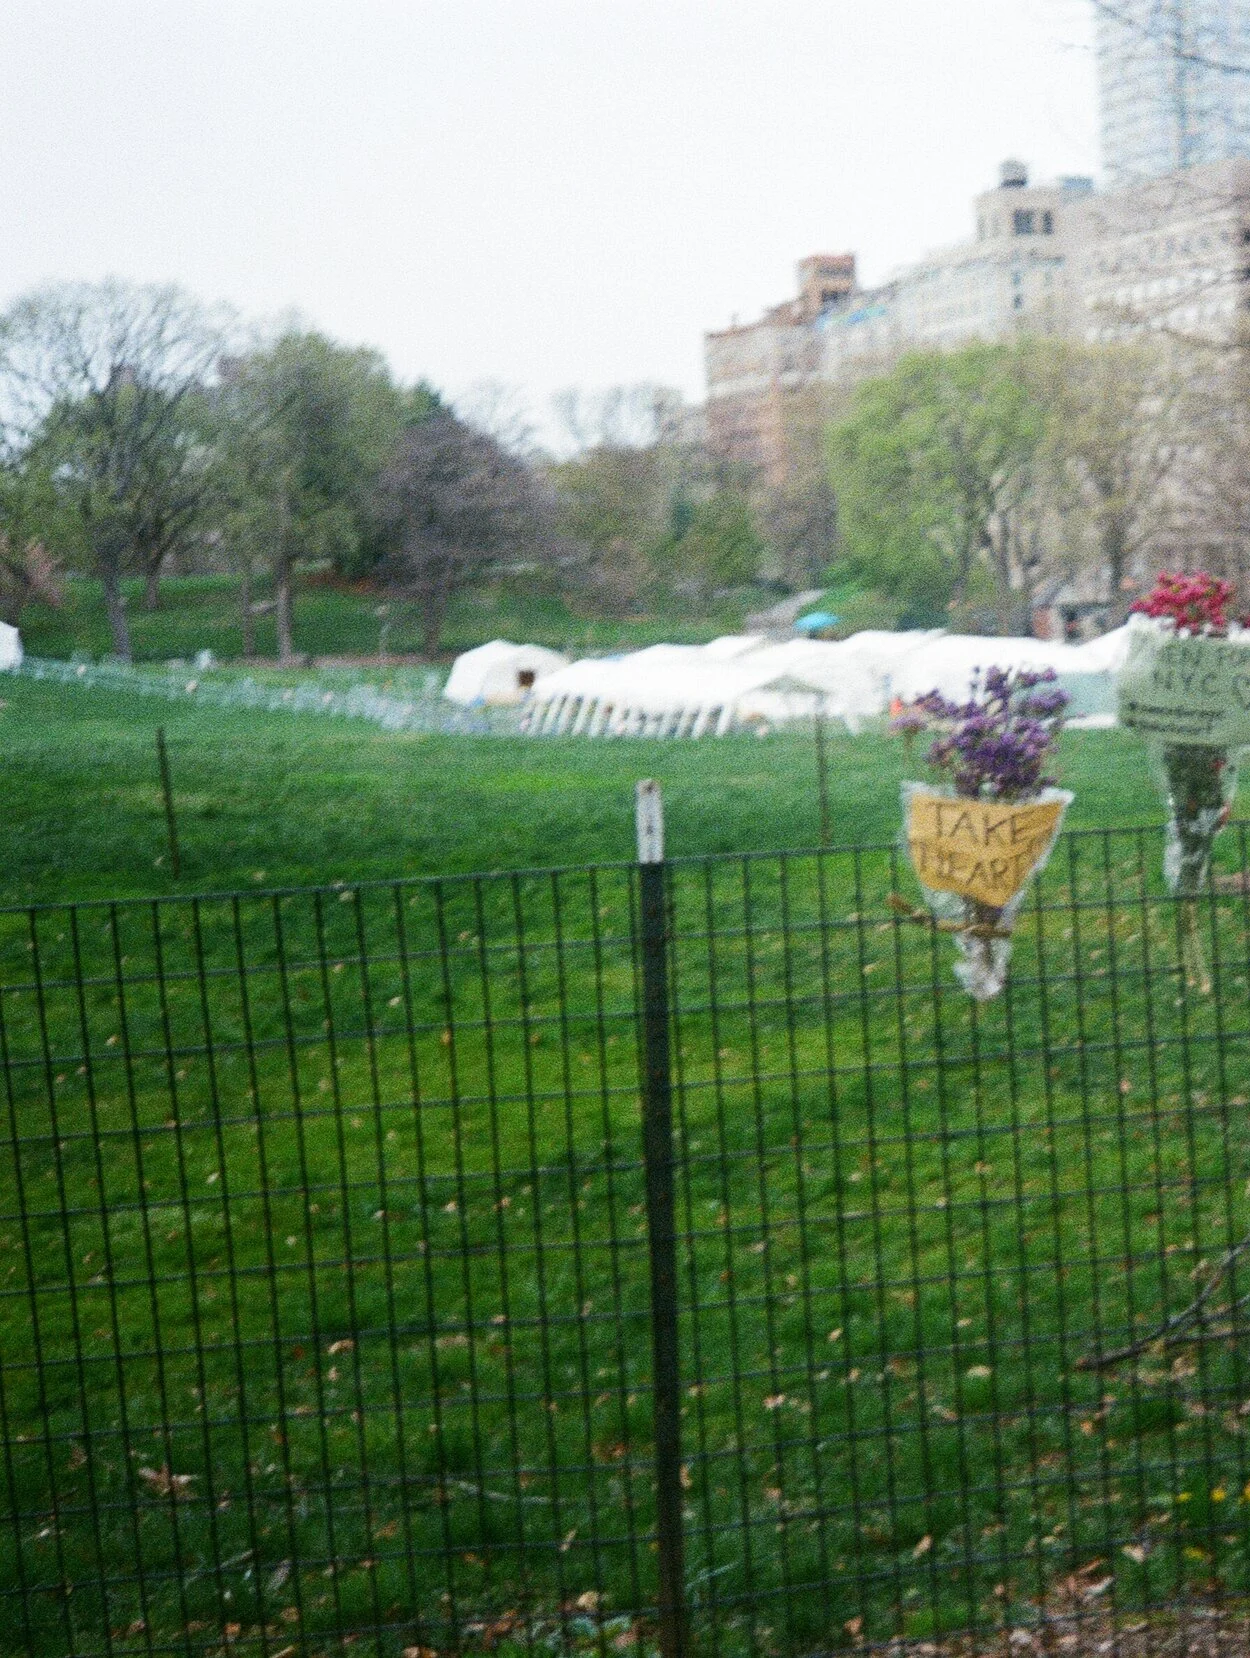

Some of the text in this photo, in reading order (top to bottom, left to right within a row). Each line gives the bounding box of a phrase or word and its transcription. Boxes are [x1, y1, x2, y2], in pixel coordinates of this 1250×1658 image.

[1152, 669, 1220, 697] NYC
[927, 801, 1039, 847] TAKE
[919, 838, 1033, 890] HEART
